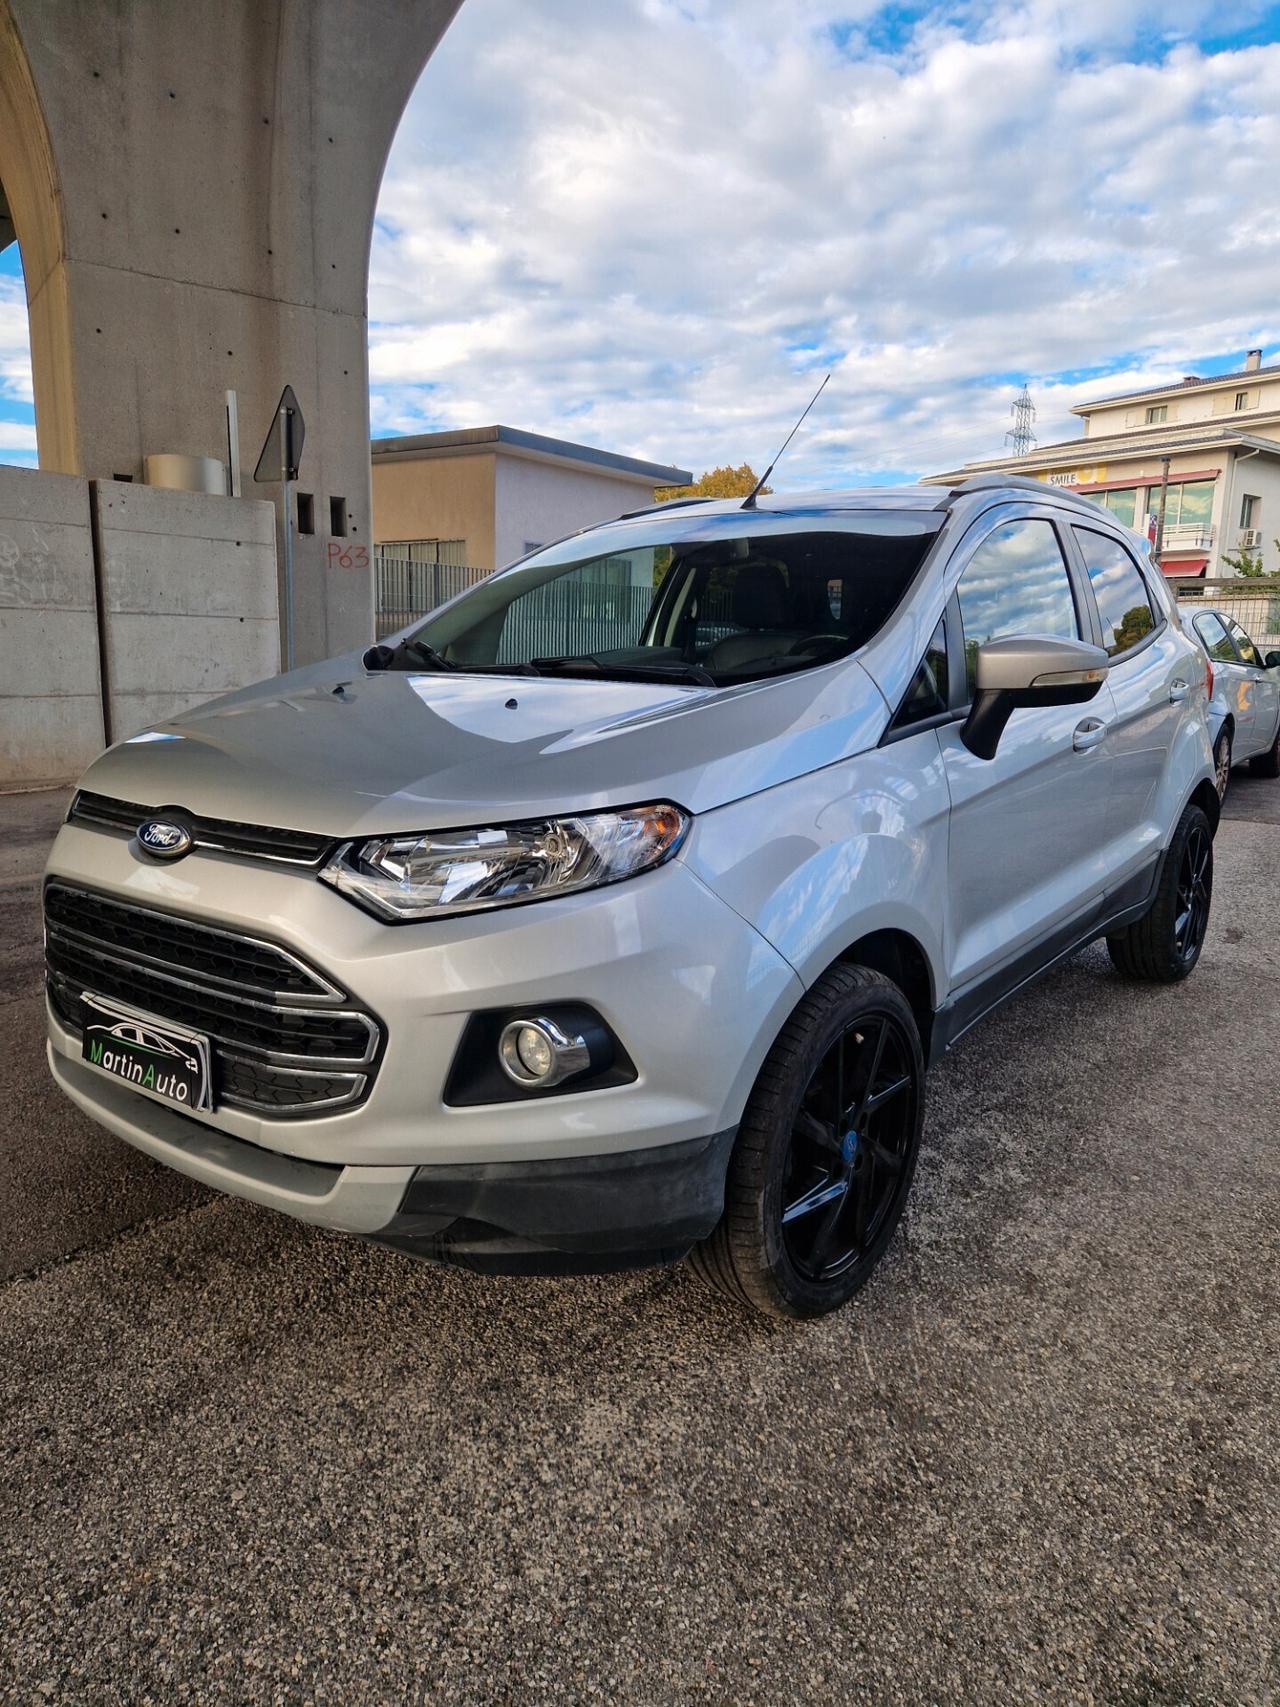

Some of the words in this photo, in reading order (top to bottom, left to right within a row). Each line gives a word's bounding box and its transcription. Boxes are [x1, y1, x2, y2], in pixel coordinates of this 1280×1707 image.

[1050, 473, 1076, 486] SMILE
[327, 543, 369, 569] P63
[144, 823, 175, 845] Ford
[90, 1039, 188, 1101] MartinAuto
